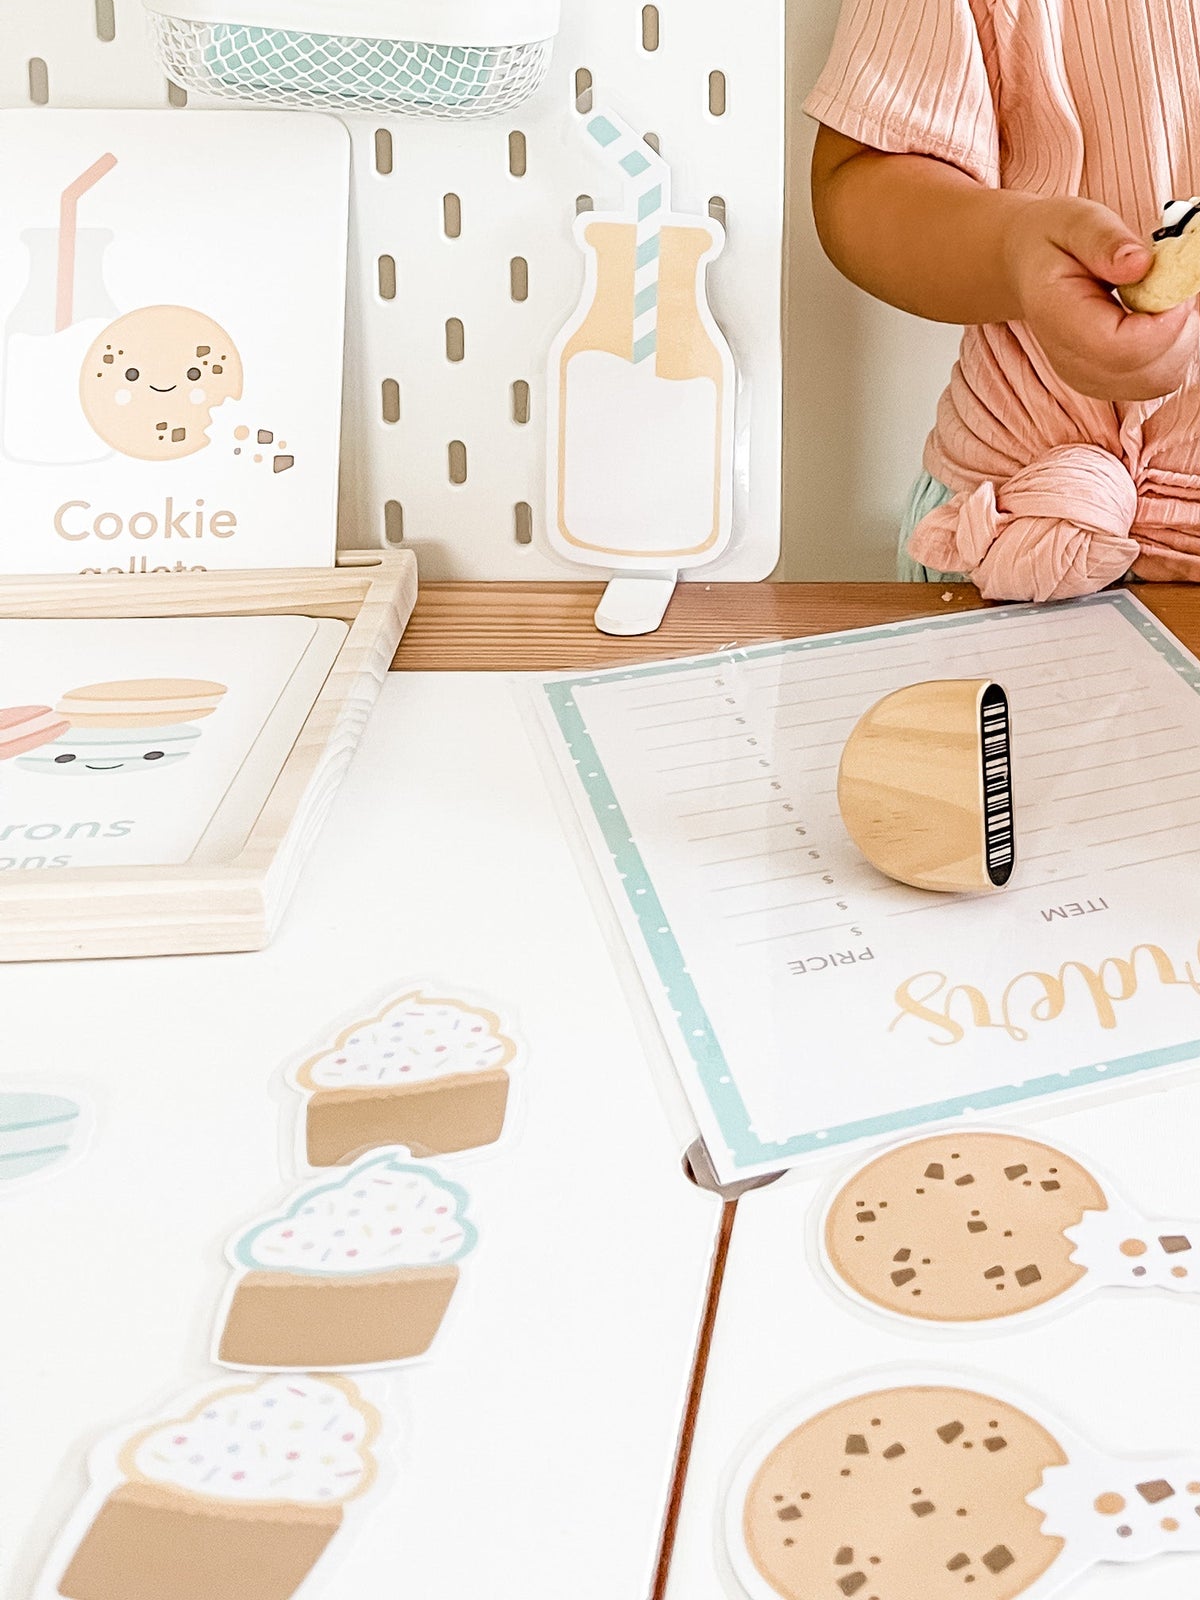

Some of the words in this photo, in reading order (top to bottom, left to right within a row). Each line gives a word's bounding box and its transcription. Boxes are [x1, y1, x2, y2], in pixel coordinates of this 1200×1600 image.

[53, 496, 238, 542] Cookie
[1041, 897, 1109, 922] ITEM
[787, 947, 875, 976] PRICE
